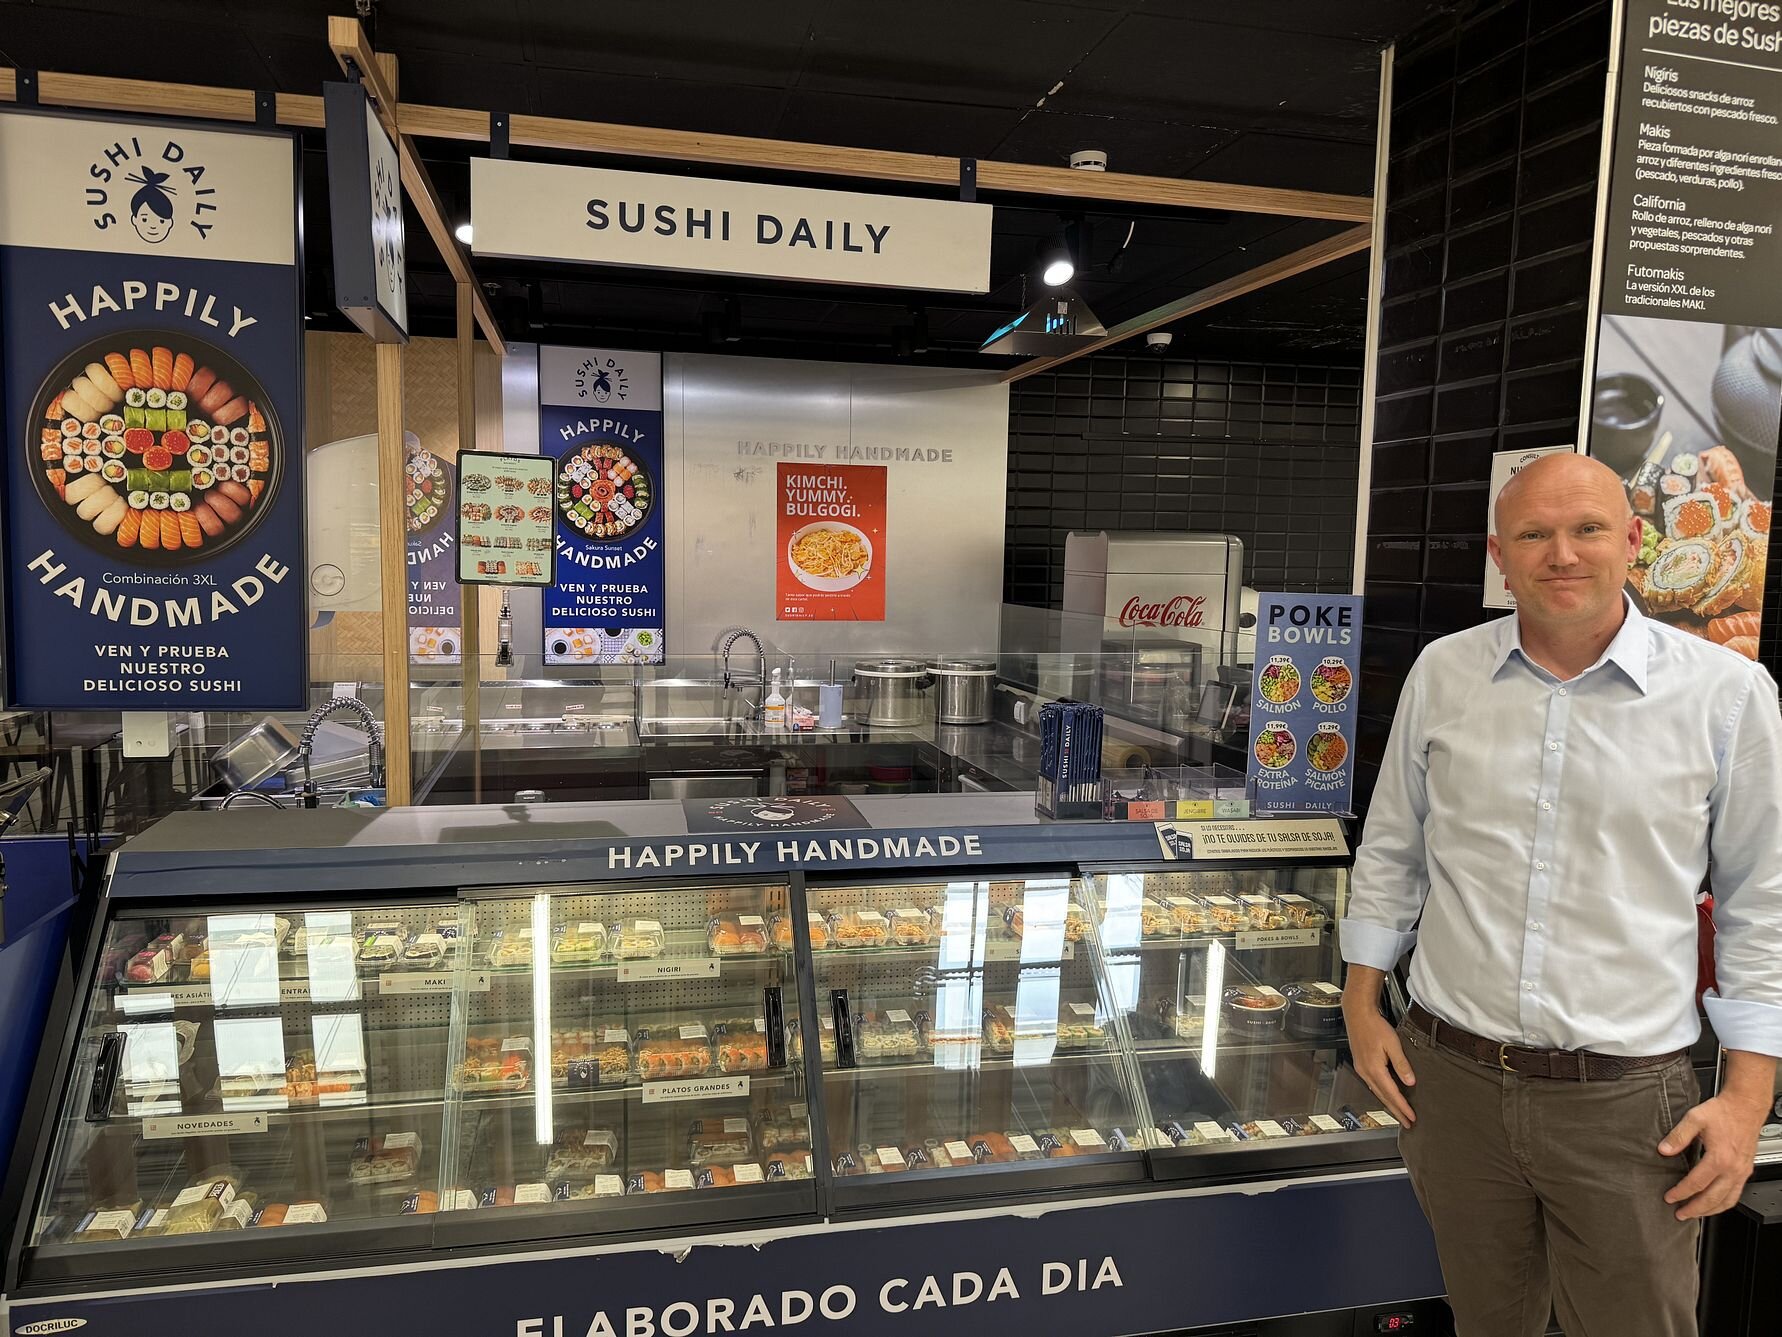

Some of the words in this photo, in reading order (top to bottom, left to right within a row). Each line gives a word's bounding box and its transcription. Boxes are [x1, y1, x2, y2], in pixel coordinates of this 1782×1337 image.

[1667, 0, 1700, 9] as
[1703, 0, 1780, 22] mejores
[1649, 12, 1711, 42] piezas
[1714, 23, 1739, 46] de
[1742, 26, 1782, 52] Sush
[1644, 65, 1679, 82] Nigiris
[1643, 82, 1688, 98] Deliciosos
[1689, 90, 1719, 102] snacks
[1719, 93, 1730, 104] de
[1732, 96, 1755, 108] arroz
[1642, 98, 1693, 112] recubiertos
[1693, 105, 1710, 115] con
[1710, 108, 1748, 120] pescado
[1749, 110, 1779, 124] fresco.
[1640, 122, 1671, 138] Makis
[1638, 139, 1661, 152] Pieza
[1662, 142, 1698, 156] formada
[1699, 148, 1714, 159] por
[1714, 149, 1732, 162] alga
[1749, 154, 1782, 166] enrollan
[1636, 154, 1659, 166] arroz
[1660, 158, 1666, 168] y
[1666, 158, 1709, 172] diferentes
[1710, 162, 1761, 177] ingredientes
[1762, 168, 1782, 180] fresc
[1636, 167, 1678, 183] (pescado,
[1678, 174, 1718, 188] verduras,
[1718, 179, 1744, 192] pollo).
[86, 137, 142, 230] SUSHI
[162, 141, 216, 240] DAILY
[1633, 194, 1686, 211] California
[586, 198, 730, 241] SUSHI
[757, 214, 890, 254] DAILY
[1632, 210, 1654, 222] Rollo
[1655, 213, 1667, 223] de
[1668, 216, 1692, 227] arroz,
[1693, 218, 1723, 230] relleno
[1724, 220, 1736, 231] de
[1736, 222, 1754, 234] alga
[1630, 226, 1636, 236] y
[1638, 226, 1681, 239] vegetales,
[1681, 230, 1724, 244] pescados
[1725, 236, 1731, 246] y
[1731, 235, 1754, 246] otras
[1629, 239, 1679, 252] propuestas
[1680, 242, 1746, 259] sorprendentes.
[1628, 264, 1685, 280] Futomakis
[1626, 280, 1636, 290] La
[1638, 282, 1670, 294] versión
[1671, 284, 1688, 295] XXL
[1690, 286, 1701, 296] de
[1702, 286, 1716, 297] los
[48, 280, 258, 338] HAPPILY
[1625, 294, 1681, 308] tradicionales
[1681, 297, 1706, 310] MAKI.
[575, 357, 598, 398] SUSHI
[606, 358, 629, 400] DAILY
[560, 419, 645, 443] HAPPILY
[738, 440, 827, 459] HAPPILY
[836, 445, 953, 463] HANDMADE
[786, 474, 848, 490] KIMCHI.
[786, 489, 851, 503] YUMMY.
[786, 504, 861, 518] BULGOGI.
[557, 535, 658, 569] HANDMADE
[102, 572, 188, 585] Combinación
[192, 574, 217, 586] 3XL
[26, 549, 290, 628] HANDMADE
[560, 583, 584, 592] VEN
[590, 584, 597, 592] Y
[602, 584, 648, 594] PRUEBA
[576, 596, 632, 604] NUESTRO
[552, 608, 617, 616] DELICIOSO
[622, 608, 656, 617] SUSHI
[1119, 596, 1207, 628] Coca-Cola
[1269, 604, 1352, 627] POKE
[1268, 627, 1352, 645] BOWLS
[95, 645, 132, 657] VEN
[140, 646, 151, 657] Y
[159, 646, 229, 658] PRUEBA
[120, 663, 205, 675] NUESTRO
[84, 680, 182, 692] DELICIOSO
[190, 680, 241, 692] SUSHI
[1312, 702, 1347, 714] POLLO
[1258, 768, 1290, 779] EXTRA
[1250, 775, 1299, 790] PROTEÍNA
[1305, 778, 1346, 791] PICANTE
[774, 798, 832, 808] DAILY
[1202, 834, 1216, 844] ¡NO
[1216, 834, 1226, 843] TE
[1226, 833, 1256, 843] OLVIDES
[1256, 833, 1266, 842] DE
[1267, 833, 1277, 842] TU
[1278, 832, 1301, 842] SALSA
[1302, 832, 1312, 841] DE
[1312, 831, 1336, 841] SOJA!
[608, 842, 761, 868] HAPPILY
[776, 835, 983, 863] HANDMADE
[177, 1120, 234, 1129] NOVEDADES
[517, 1285, 856, 1337] ELABORADO
[878, 1267, 1020, 1313] CADA
[1041, 1256, 1123, 1296] DIA
[26, 1320, 78, 1334] DOCRILUC
